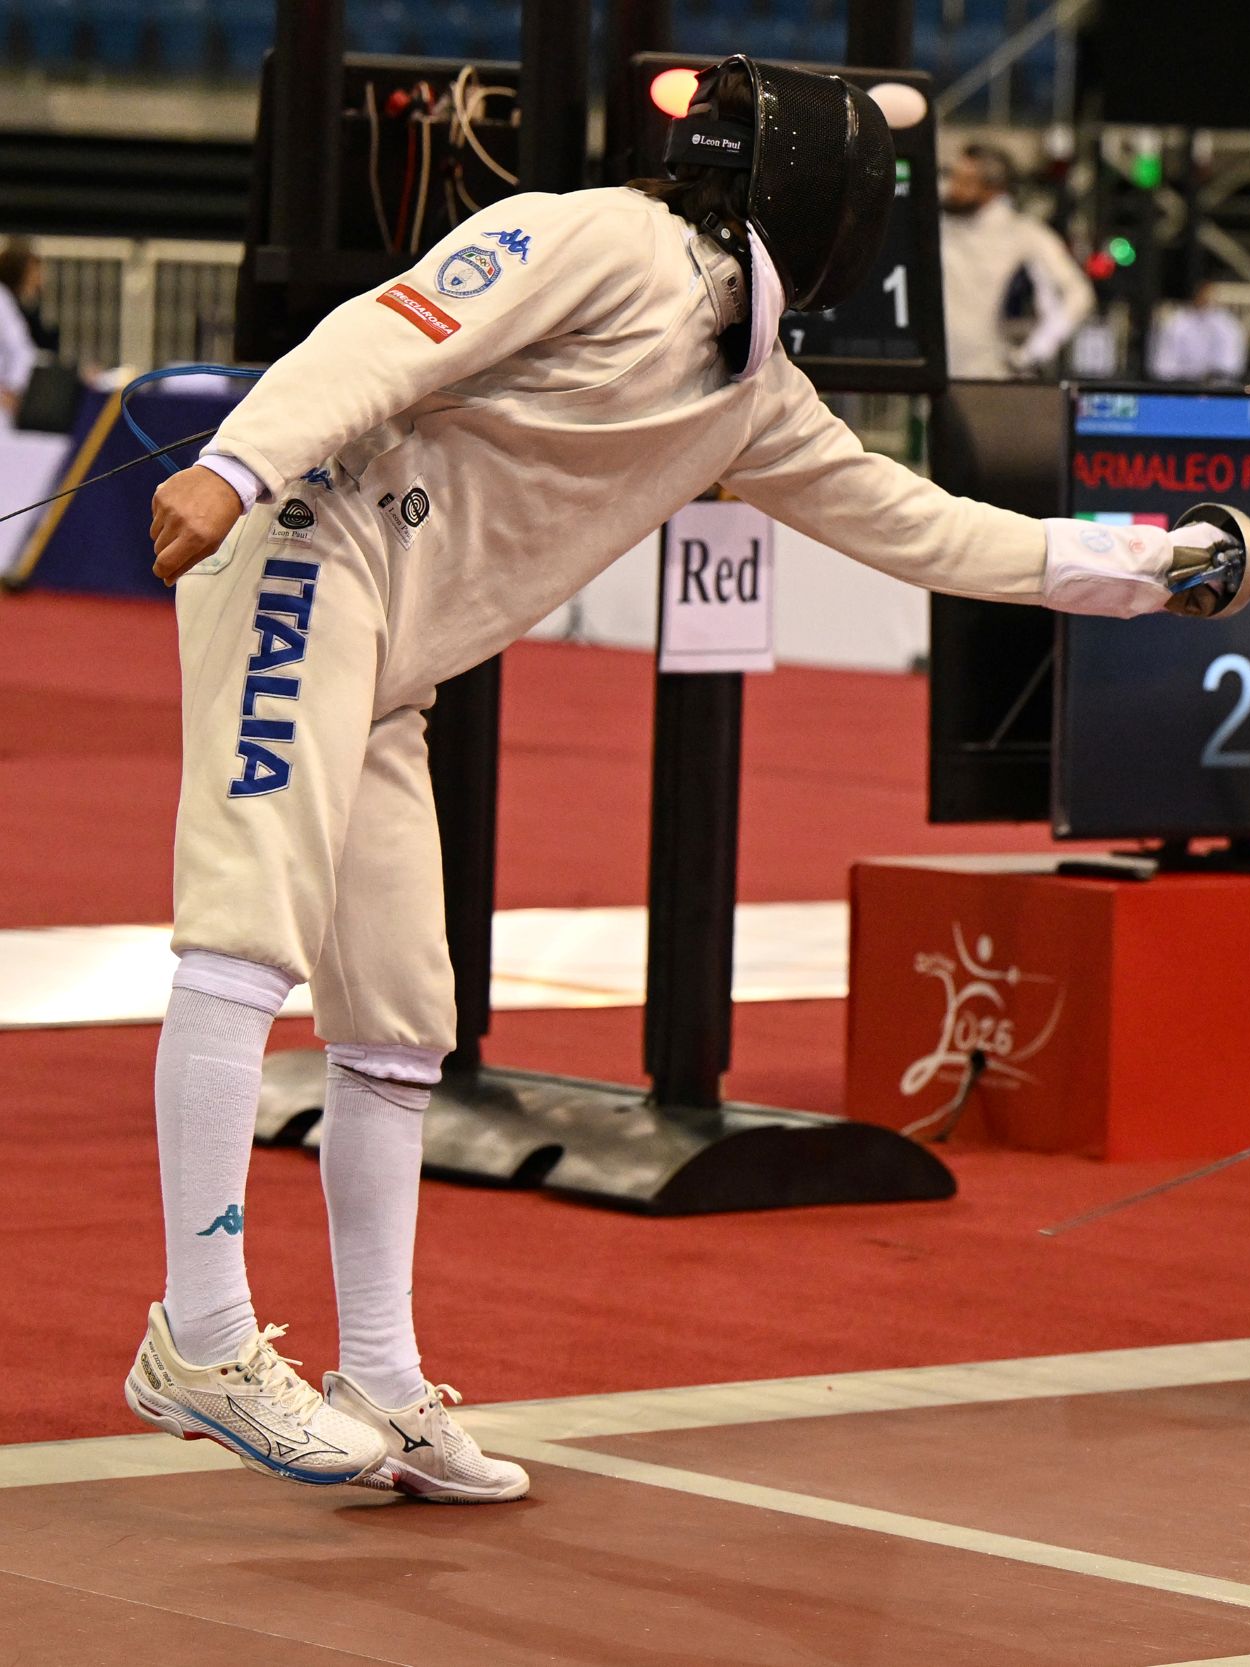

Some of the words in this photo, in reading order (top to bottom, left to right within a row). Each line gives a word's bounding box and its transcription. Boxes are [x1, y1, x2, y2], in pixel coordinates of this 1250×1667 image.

[700, 135, 720, 147] Leon
[721, 138, 741, 150] Paul
[388, 289, 454, 335] FRECCIAROSSA
[883, 264, 910, 328] 1
[272, 528, 290, 537] Leon
[291, 530, 308, 539] Paul
[678, 538, 762, 605] Red
[228, 558, 321, 798] ITALIA
